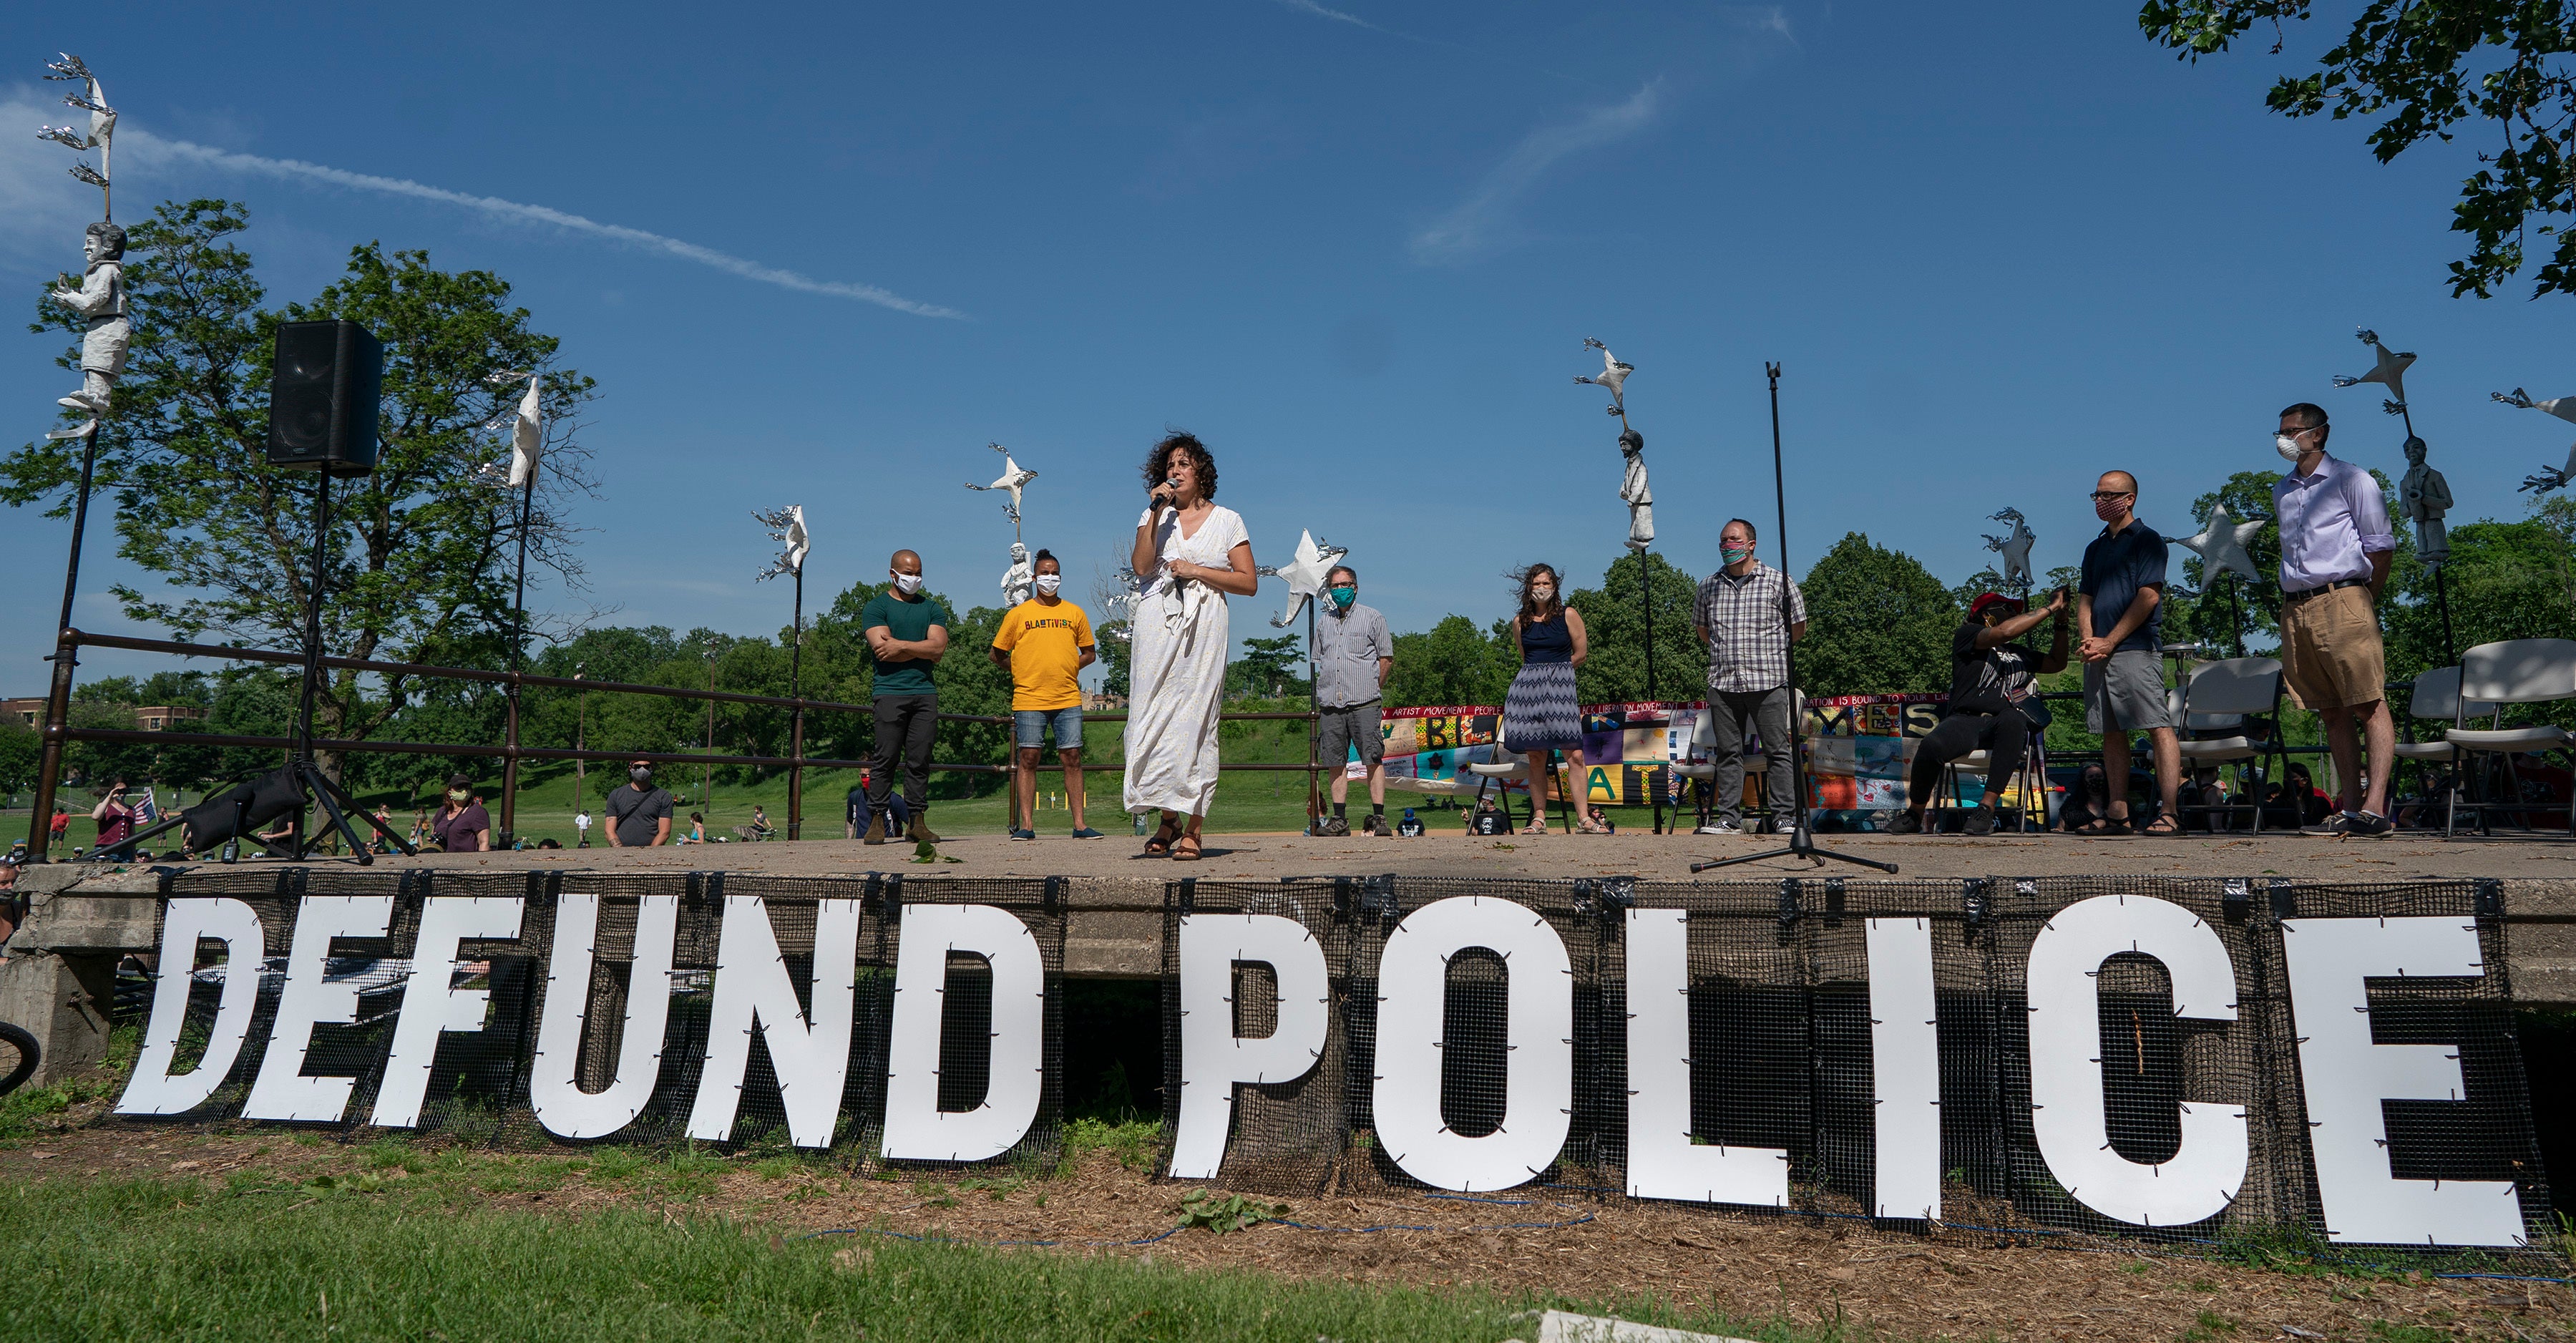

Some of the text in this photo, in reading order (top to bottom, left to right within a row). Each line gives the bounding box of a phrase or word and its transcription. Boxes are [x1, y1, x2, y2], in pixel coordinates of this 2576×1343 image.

[1392, 708, 1420, 716] ARTIST
[1424, 706, 1467, 716] MOVEMENT
[1475, 705, 1501, 716] PEOPLE
[1599, 703, 1634, 714] LIBERATION
[1636, 702, 1678, 712] MOVEMENT
[1687, 701, 1696, 710] BE
[1839, 696, 1848, 705] IS
[1852, 695, 1881, 705] BOUND
[1888, 694, 1899, 703] TO
[1903, 693, 1927, 702] YOUR
[112, 893, 2527, 1247] DEFUND POLICE
